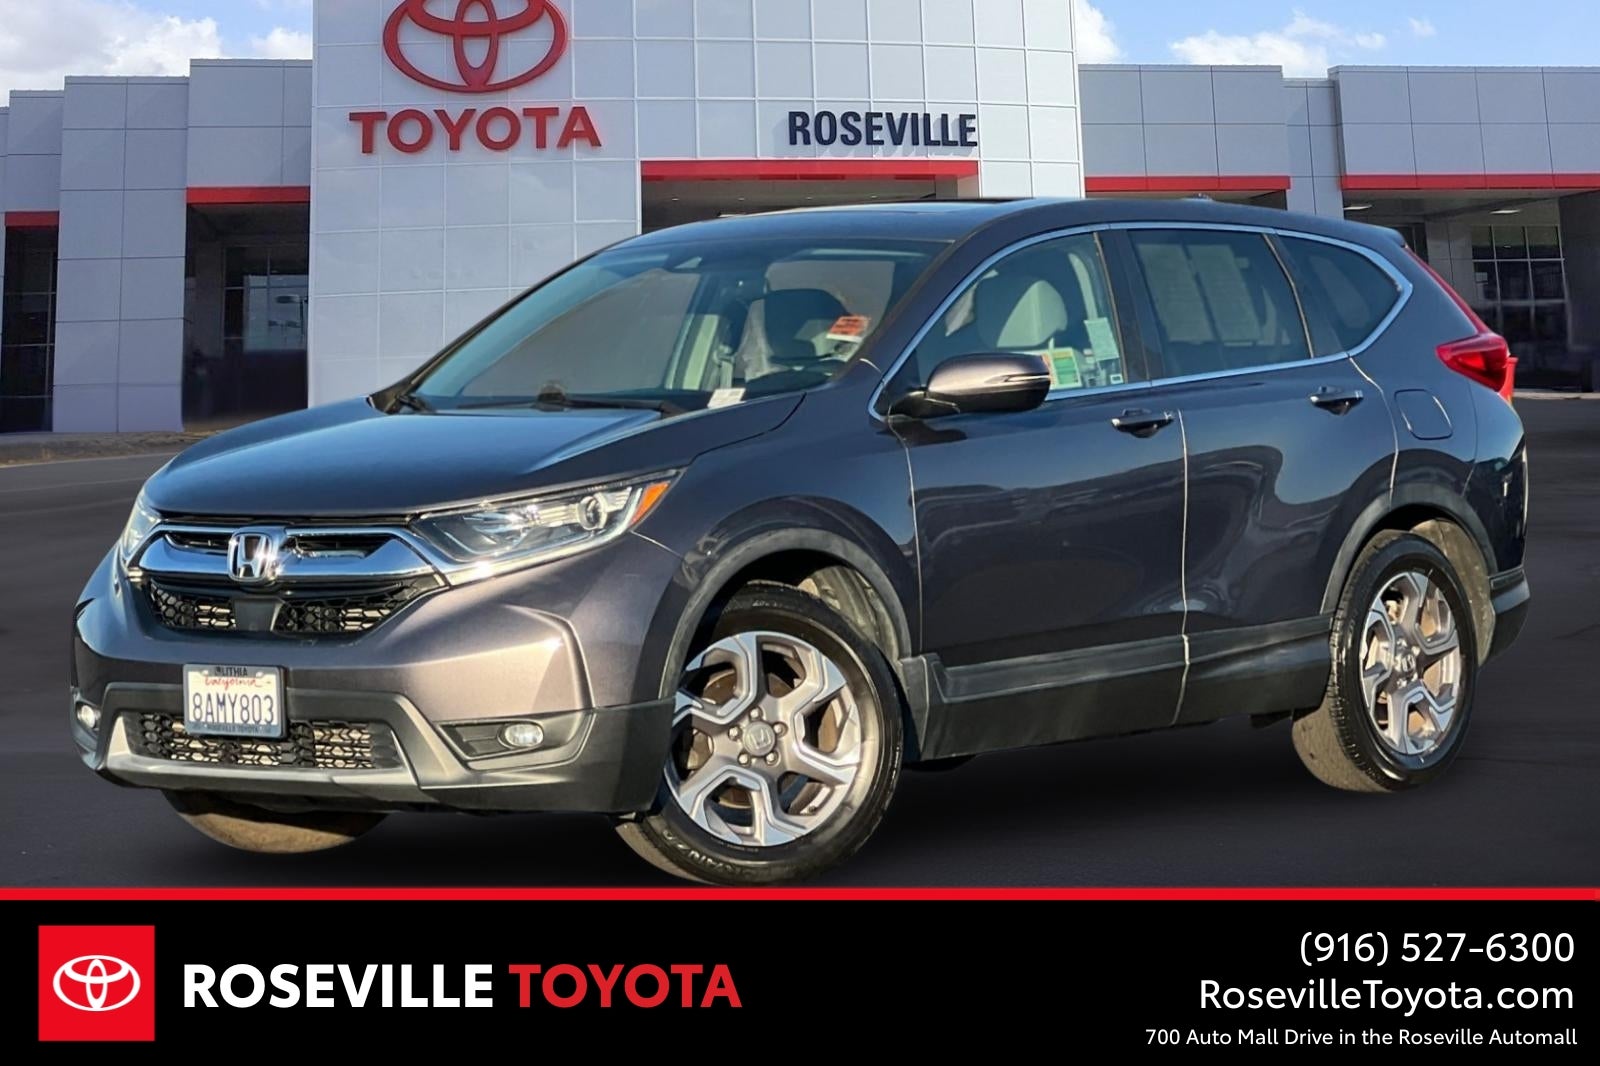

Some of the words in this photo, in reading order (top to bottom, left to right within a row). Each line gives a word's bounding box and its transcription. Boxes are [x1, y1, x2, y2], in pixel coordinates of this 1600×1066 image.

[349, 106, 602, 154] TOYOTA
[788, 111, 978, 147] ROSEVILLE
[192, 692, 274, 724] 8AMY803
